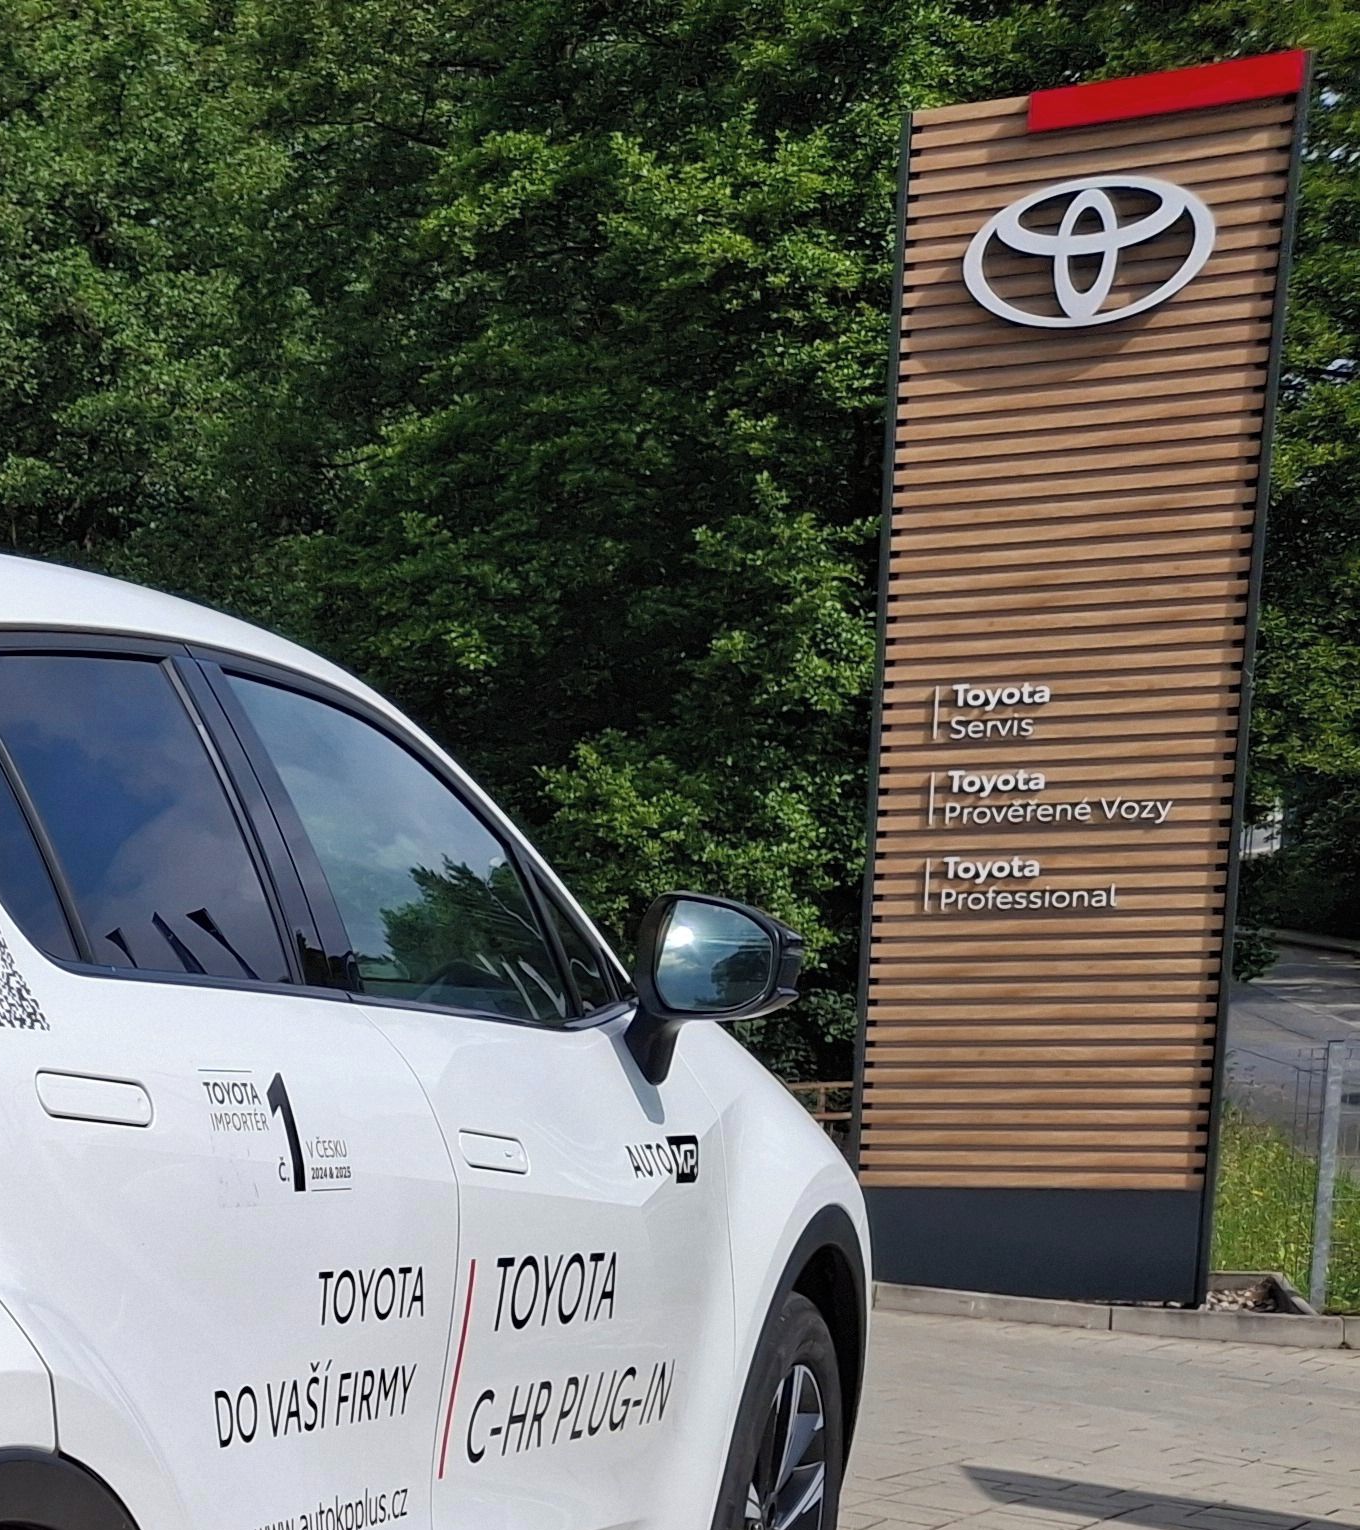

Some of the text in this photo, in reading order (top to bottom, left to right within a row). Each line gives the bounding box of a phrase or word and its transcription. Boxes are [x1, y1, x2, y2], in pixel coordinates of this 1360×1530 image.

[952, 682, 1051, 712] Toyota
[950, 714, 1034, 740] Servis
[947, 769, 1046, 798] Toyota
[944, 796, 1173, 826] Prověřené Vozy
[942, 855, 1041, 884] Toyota
[940, 883, 1117, 912] Professional
[202, 1081, 262, 1106] TOYOTA
[210, 1109, 270, 1132] IMPORTÉR
[266, 1072, 307, 1193] 1
[305, 1136, 348, 1159] V ČESKU
[624, 1142, 674, 1180] AUTO
[311, 1166, 327, 1180] 2024
[335, 1166, 352, 1179] 2025
[318, 1266, 425, 1327] TOYOTA
[493, 1251, 618, 1332] TOYOTA
[213, 1358, 418, 1449] DO VAŠÍ FIRMY
[466, 1358, 677, 1464] C-HR PLUG-IN
